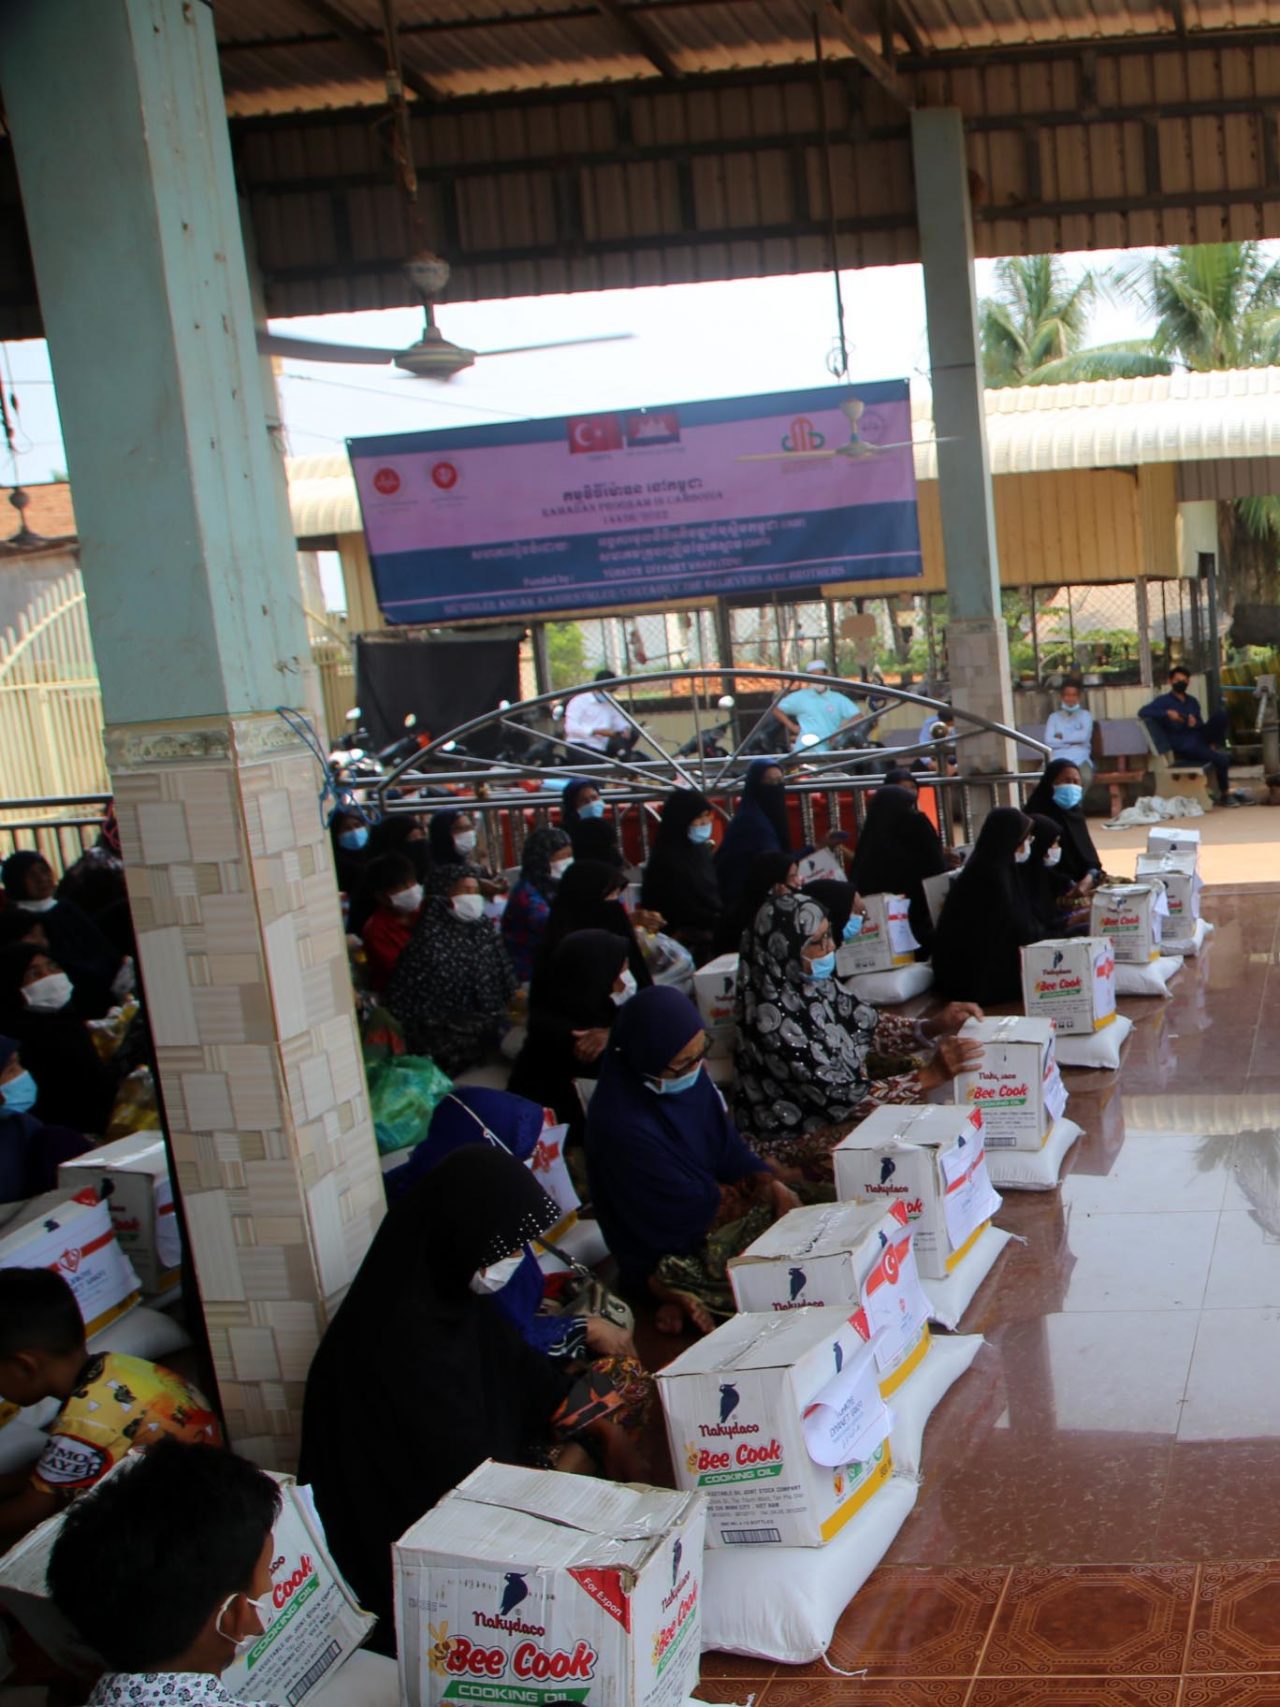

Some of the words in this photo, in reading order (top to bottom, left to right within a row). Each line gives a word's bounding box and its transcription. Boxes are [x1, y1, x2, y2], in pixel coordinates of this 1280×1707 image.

[1059, 976, 1082, 988] Cook
[974, 1086, 995, 1099] Bee
[999, 1083, 1028, 1097] Cook
[864, 1184, 909, 1195] Nakydaco
[905, 1200, 923, 1213] ok
[698, 1423, 760, 1440] Nakydaco
[697, 1448, 730, 1471] Bee
[735, 1440, 782, 1466] Cook
[704, 1471, 755, 1484] COOKING
[757, 1467, 776, 1479] OIL
[273, 1554, 312, 1608] Cook
[583, 1576, 598, 1594] For
[597, 1590, 623, 1617] Export
[252, 1604, 297, 1658] COOKING
[299, 1586, 315, 1602] OIL
[472, 1611, 545, 1637] Nakydaco
[447, 1637, 504, 1676] Bee
[513, 1642, 595, 1680] Cook
[458, 1683, 539, 1702] COOKING
[543, 1687, 575, 1703] OIL
